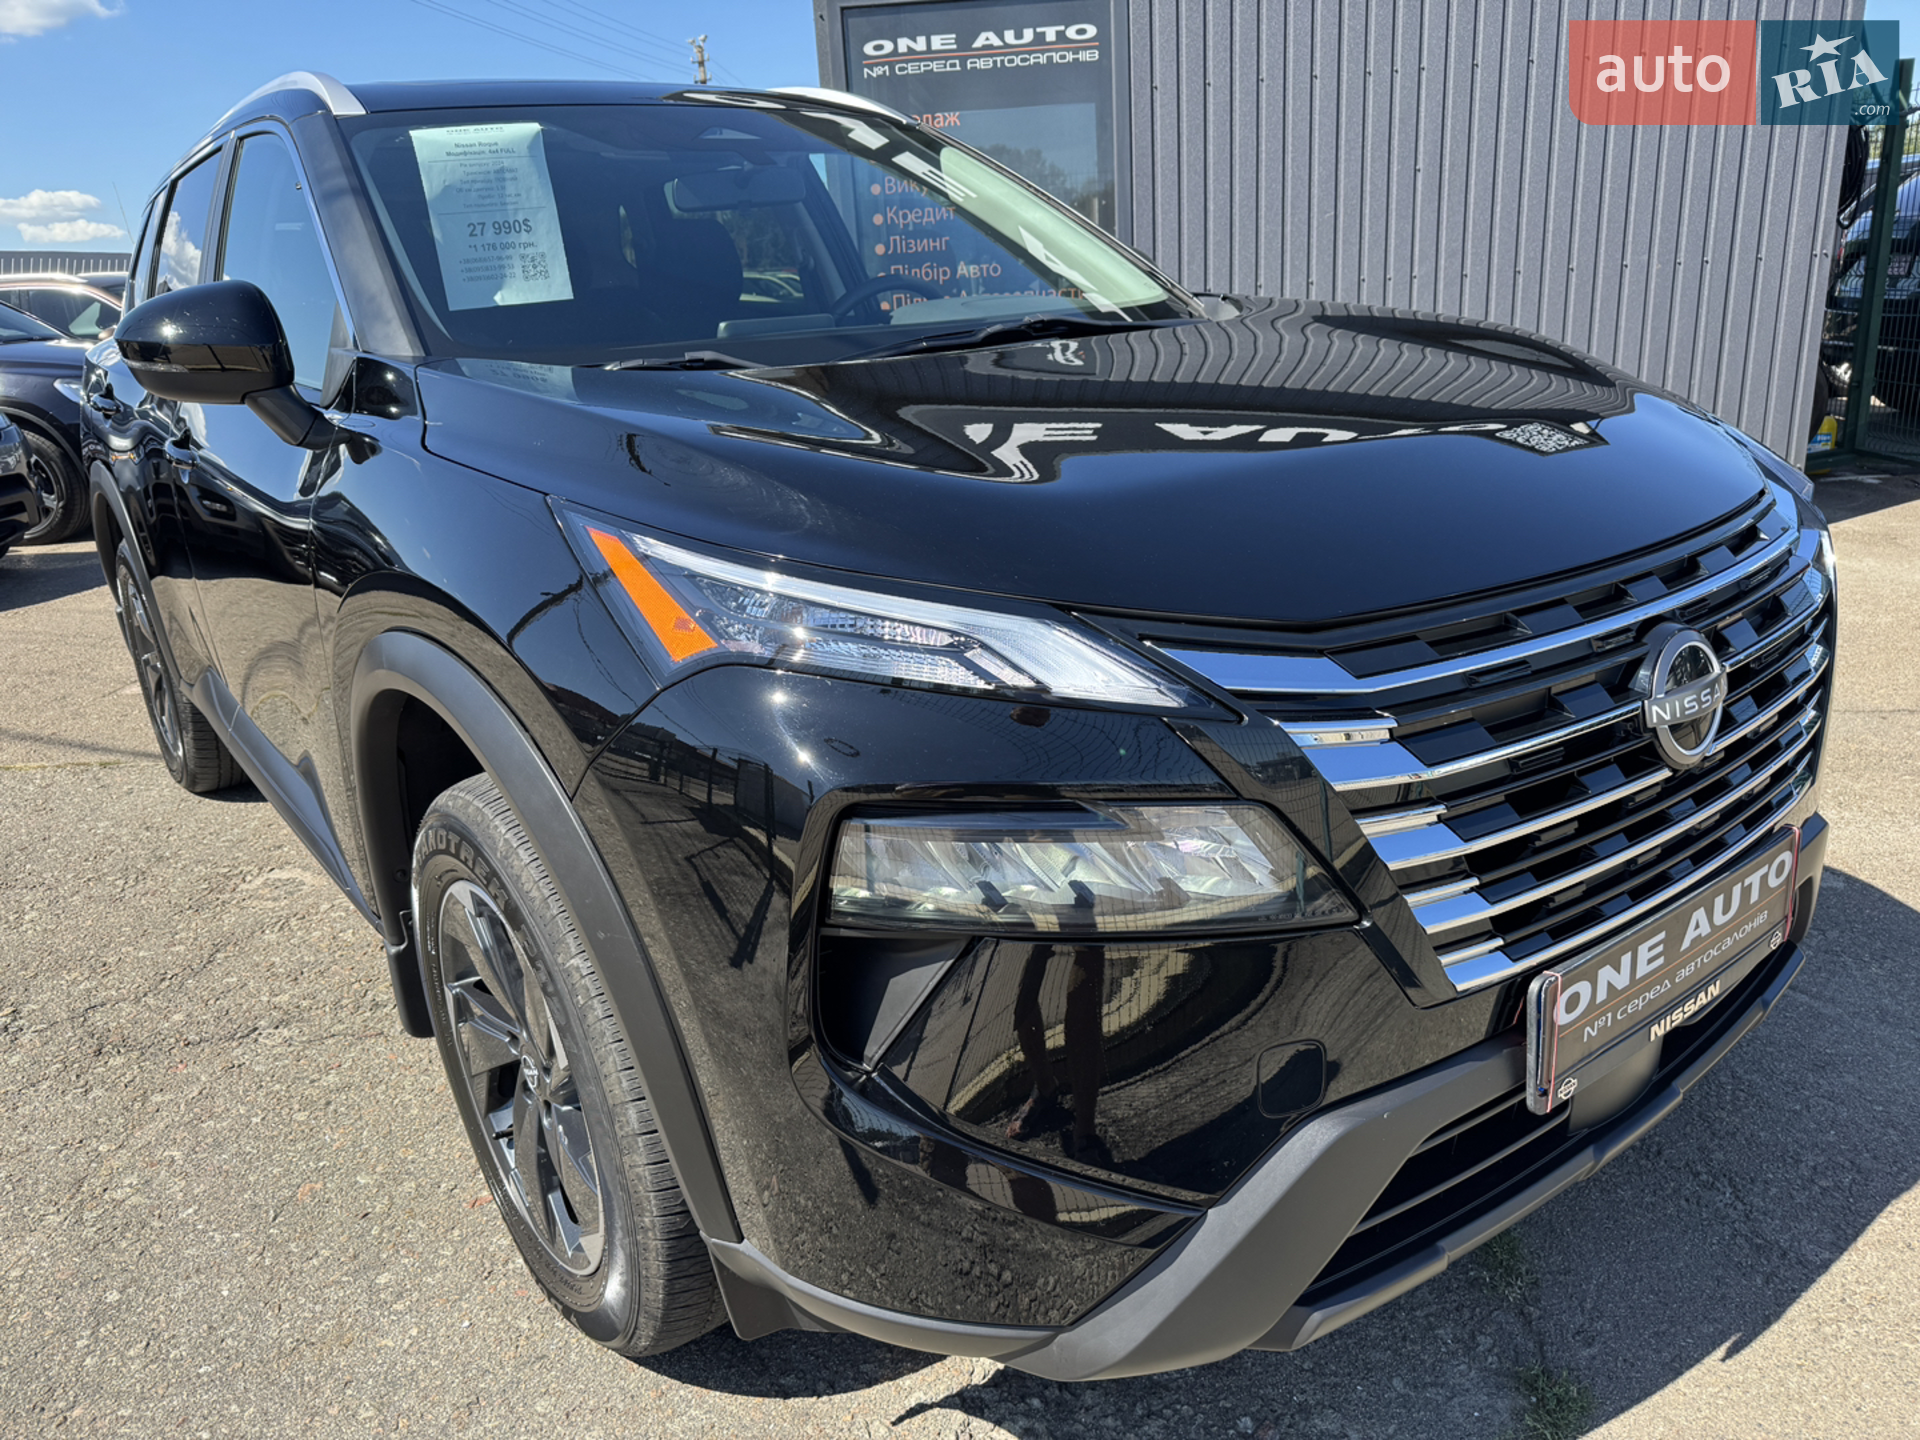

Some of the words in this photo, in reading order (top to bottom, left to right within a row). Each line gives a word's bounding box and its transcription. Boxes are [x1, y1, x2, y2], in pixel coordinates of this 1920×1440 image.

[862, 33, 957, 56] ONE
[971, 23, 1098, 48] AUTO
[895, 59, 961, 75] СЕРЕД
[967, 49, 1099, 70] АВТОСАЛОНІВ
[467, 221, 486, 238] 27
[492, 218, 533, 236] 990$
[886, 205, 956, 229] Кредит
[481, 242, 497, 252] 176
[499, 241, 516, 250] 000
[888, 235, 950, 255] Лізинг
[956, 261, 1002, 279] Авто
[1553, 930, 1667, 1026] ONE
[1680, 850, 1793, 952] AUTO
[1616, 980, 1672, 1021] серед
[1675, 910, 1768, 984] автосалонів
[1650, 980, 1721, 1042] NISSAN
